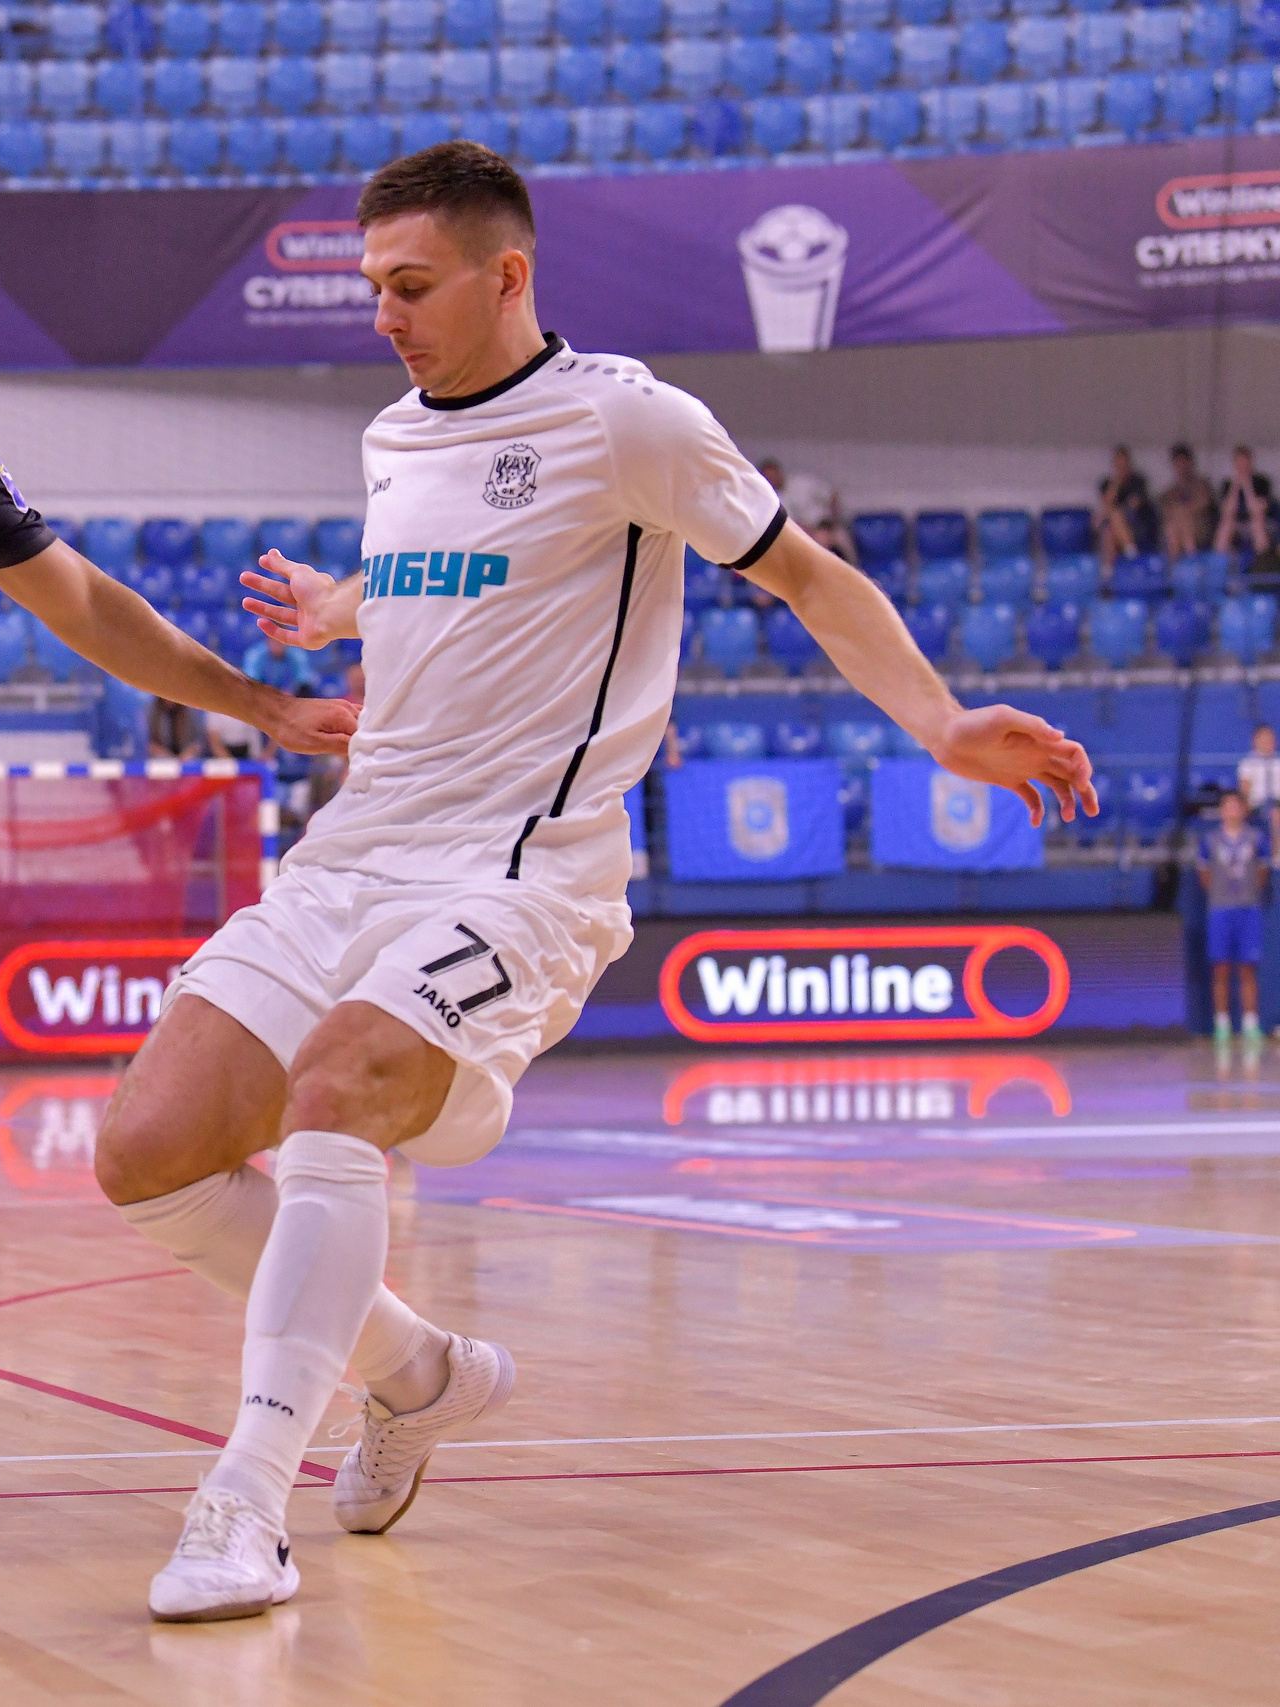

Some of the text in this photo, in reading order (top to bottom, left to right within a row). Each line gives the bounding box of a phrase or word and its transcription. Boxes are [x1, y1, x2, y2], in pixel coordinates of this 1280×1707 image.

[1136, 228, 1280, 269] СУПЕРКУ
[243, 274, 378, 309] СУПЕРК
[29, 965, 180, 1026] Win
[419, 923, 514, 1017] 77
[697, 954, 954, 1016] Winline
[413, 983, 462, 1029] JAKO
